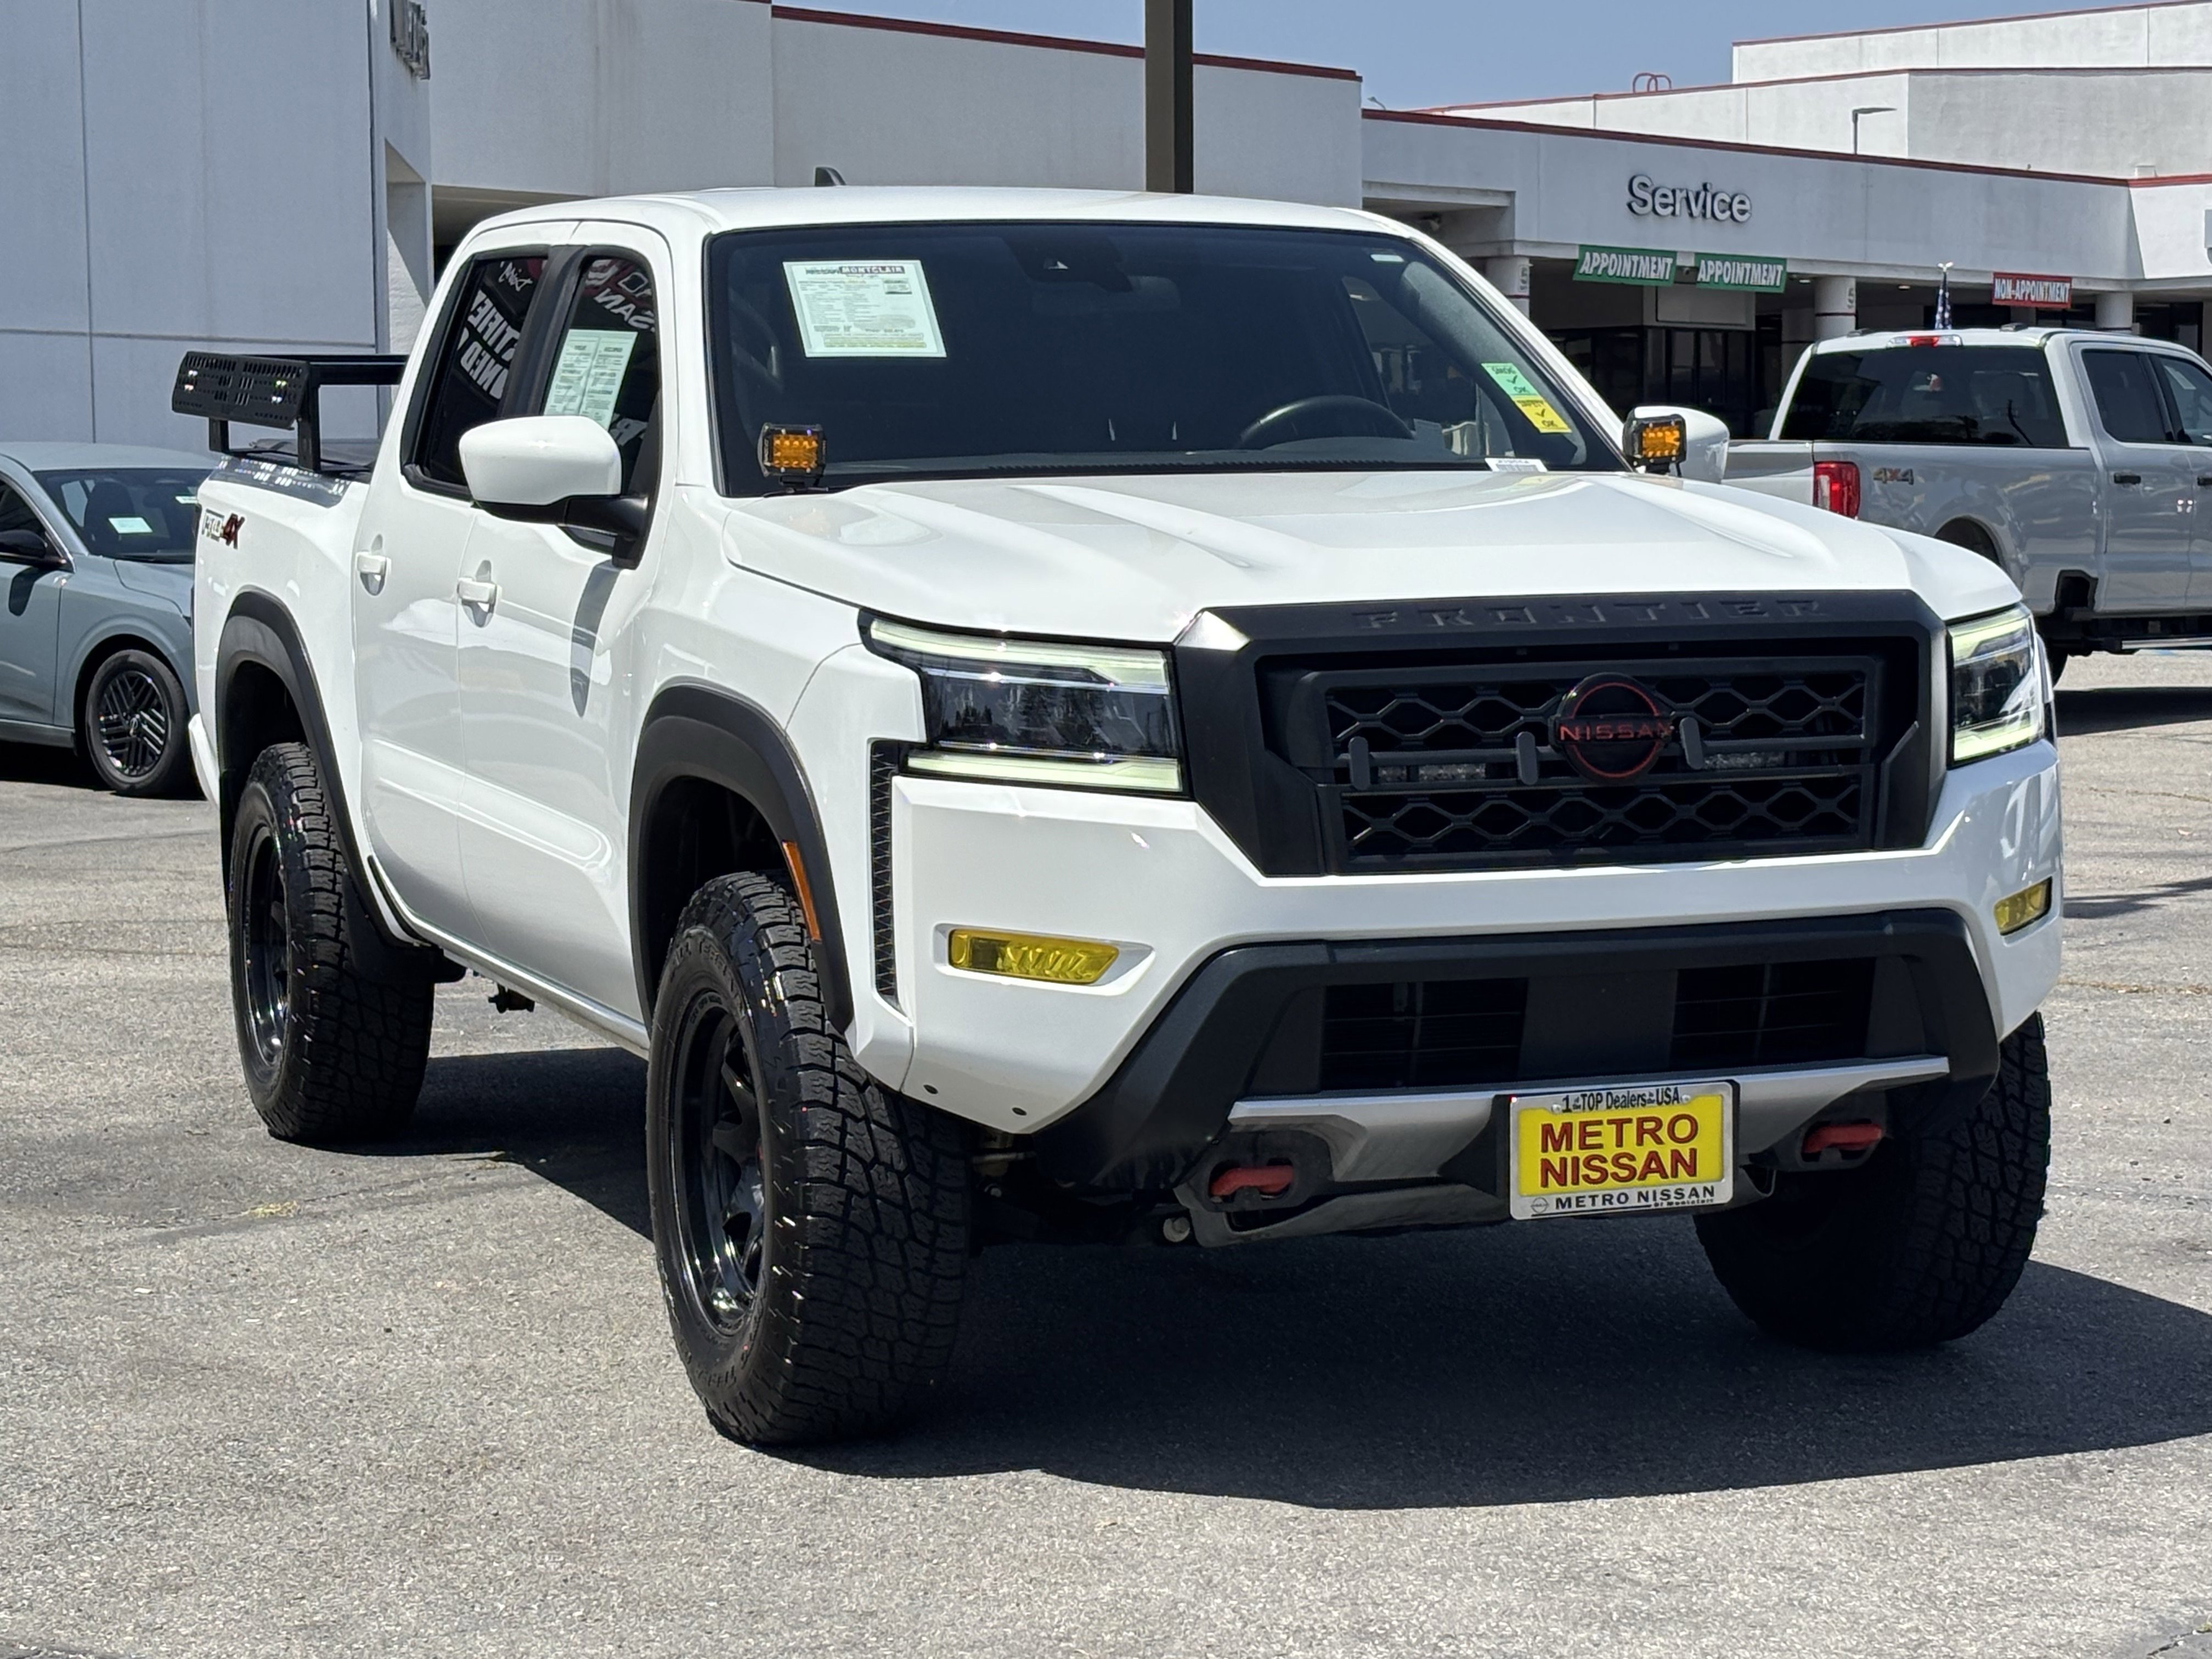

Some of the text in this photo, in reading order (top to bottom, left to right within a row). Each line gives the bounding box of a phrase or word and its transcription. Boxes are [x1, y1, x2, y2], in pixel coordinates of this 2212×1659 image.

[1627, 174, 1752, 223] Service
[1578, 251, 1673, 280] APPOINTMENT
[1697, 259, 1784, 286] APPOINTMENT
[1994, 278, 2070, 303] NON-APPOINTMENT
[1351, 599, 1825, 629] FRONTIER
[1560, 721, 1672, 741] NISSAN
[1562, 1094, 1572, 1113] 1
[1581, 1092, 1603, 1111] TOP
[1606, 1091, 1646, 1110] Dealers
[1656, 1087, 1680, 1105] USA
[1541, 1113, 1699, 1153] METRO
[1540, 1148, 1698, 1188] NISSAN
[1555, 1186, 1715, 1210] METRO NISSAN
